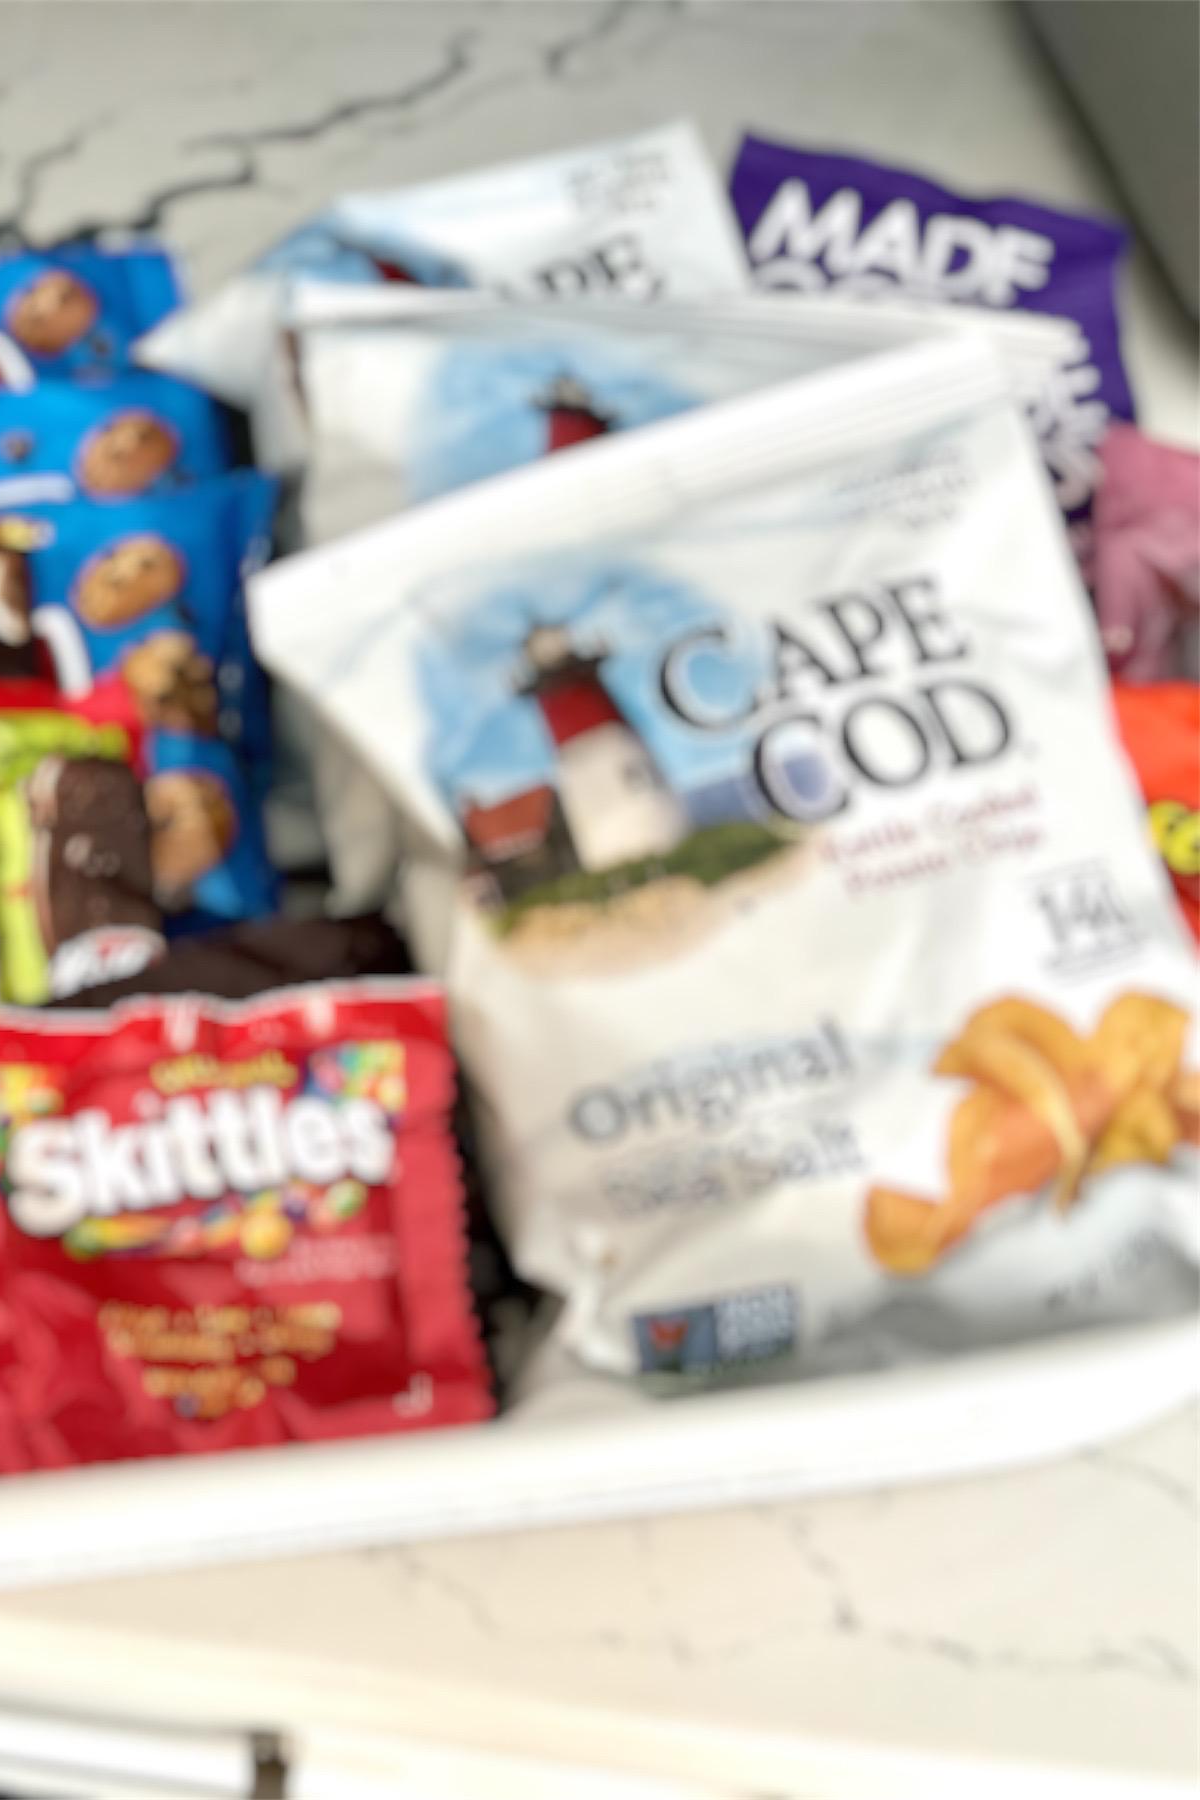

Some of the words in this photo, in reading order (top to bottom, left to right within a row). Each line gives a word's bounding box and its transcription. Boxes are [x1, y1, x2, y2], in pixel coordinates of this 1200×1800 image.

[748, 177, 1056, 305] MADE
[661, 577, 968, 730] CAPE
[752, 680, 1014, 824] COD
[6, 1086, 396, 1236] Skittles
